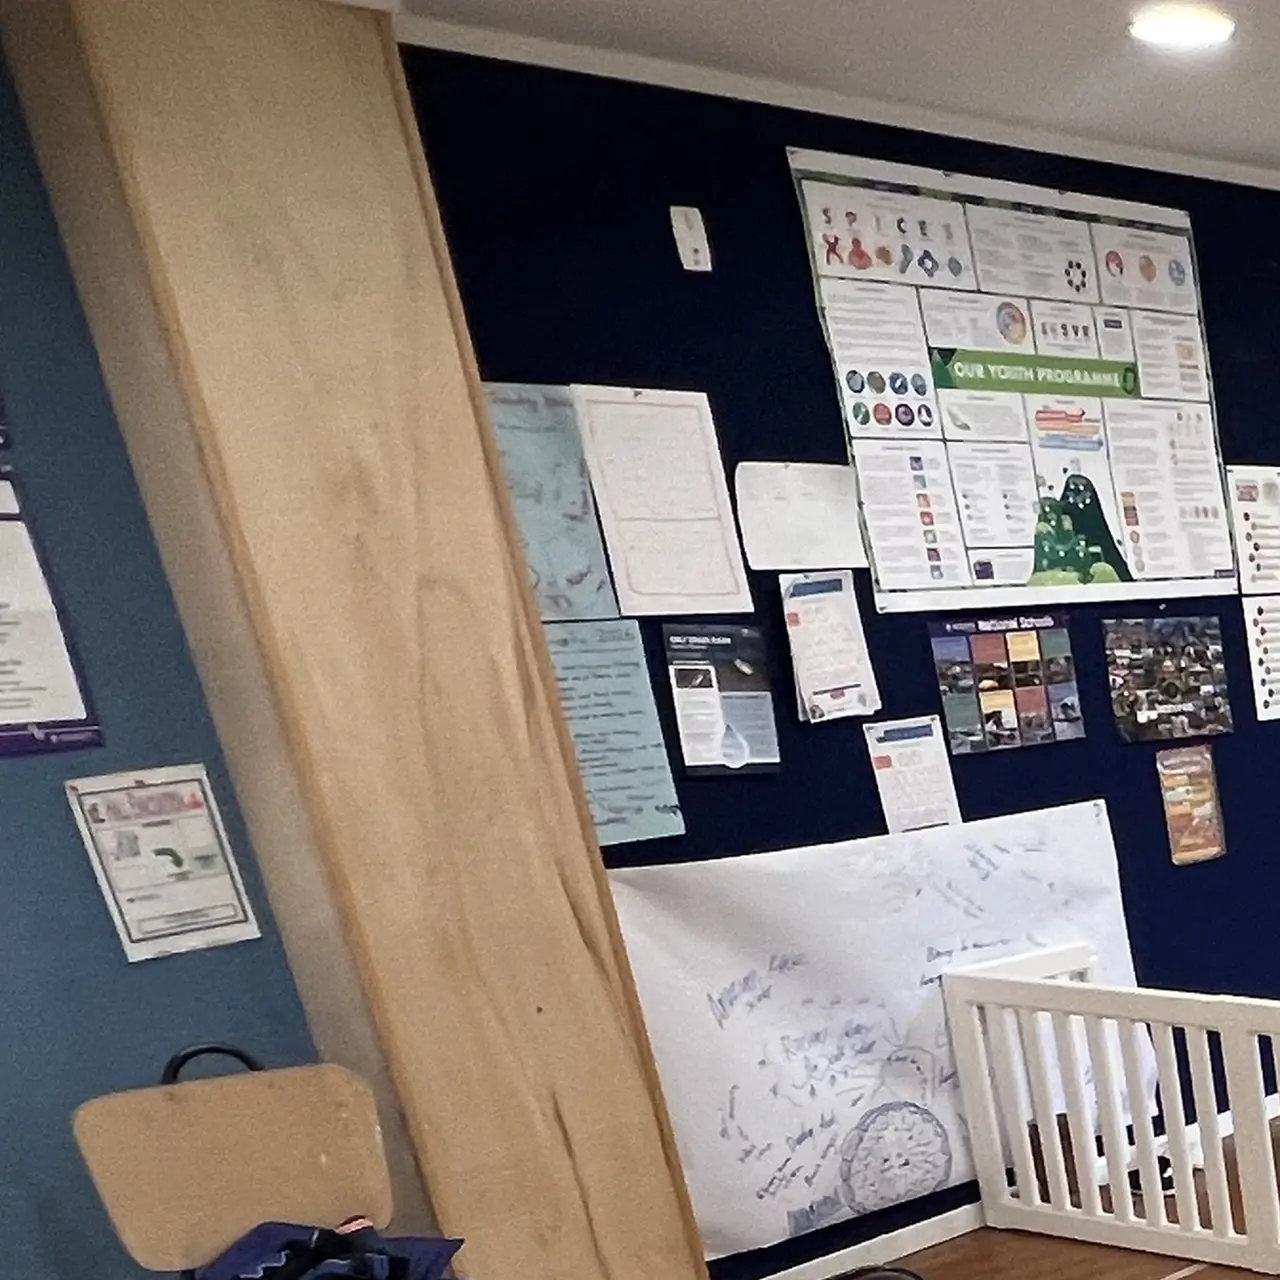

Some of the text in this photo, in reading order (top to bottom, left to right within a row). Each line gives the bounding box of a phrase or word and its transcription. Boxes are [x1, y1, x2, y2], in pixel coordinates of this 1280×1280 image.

[954, 362, 1122, 388] OUR YOUTH PROGRAMME
